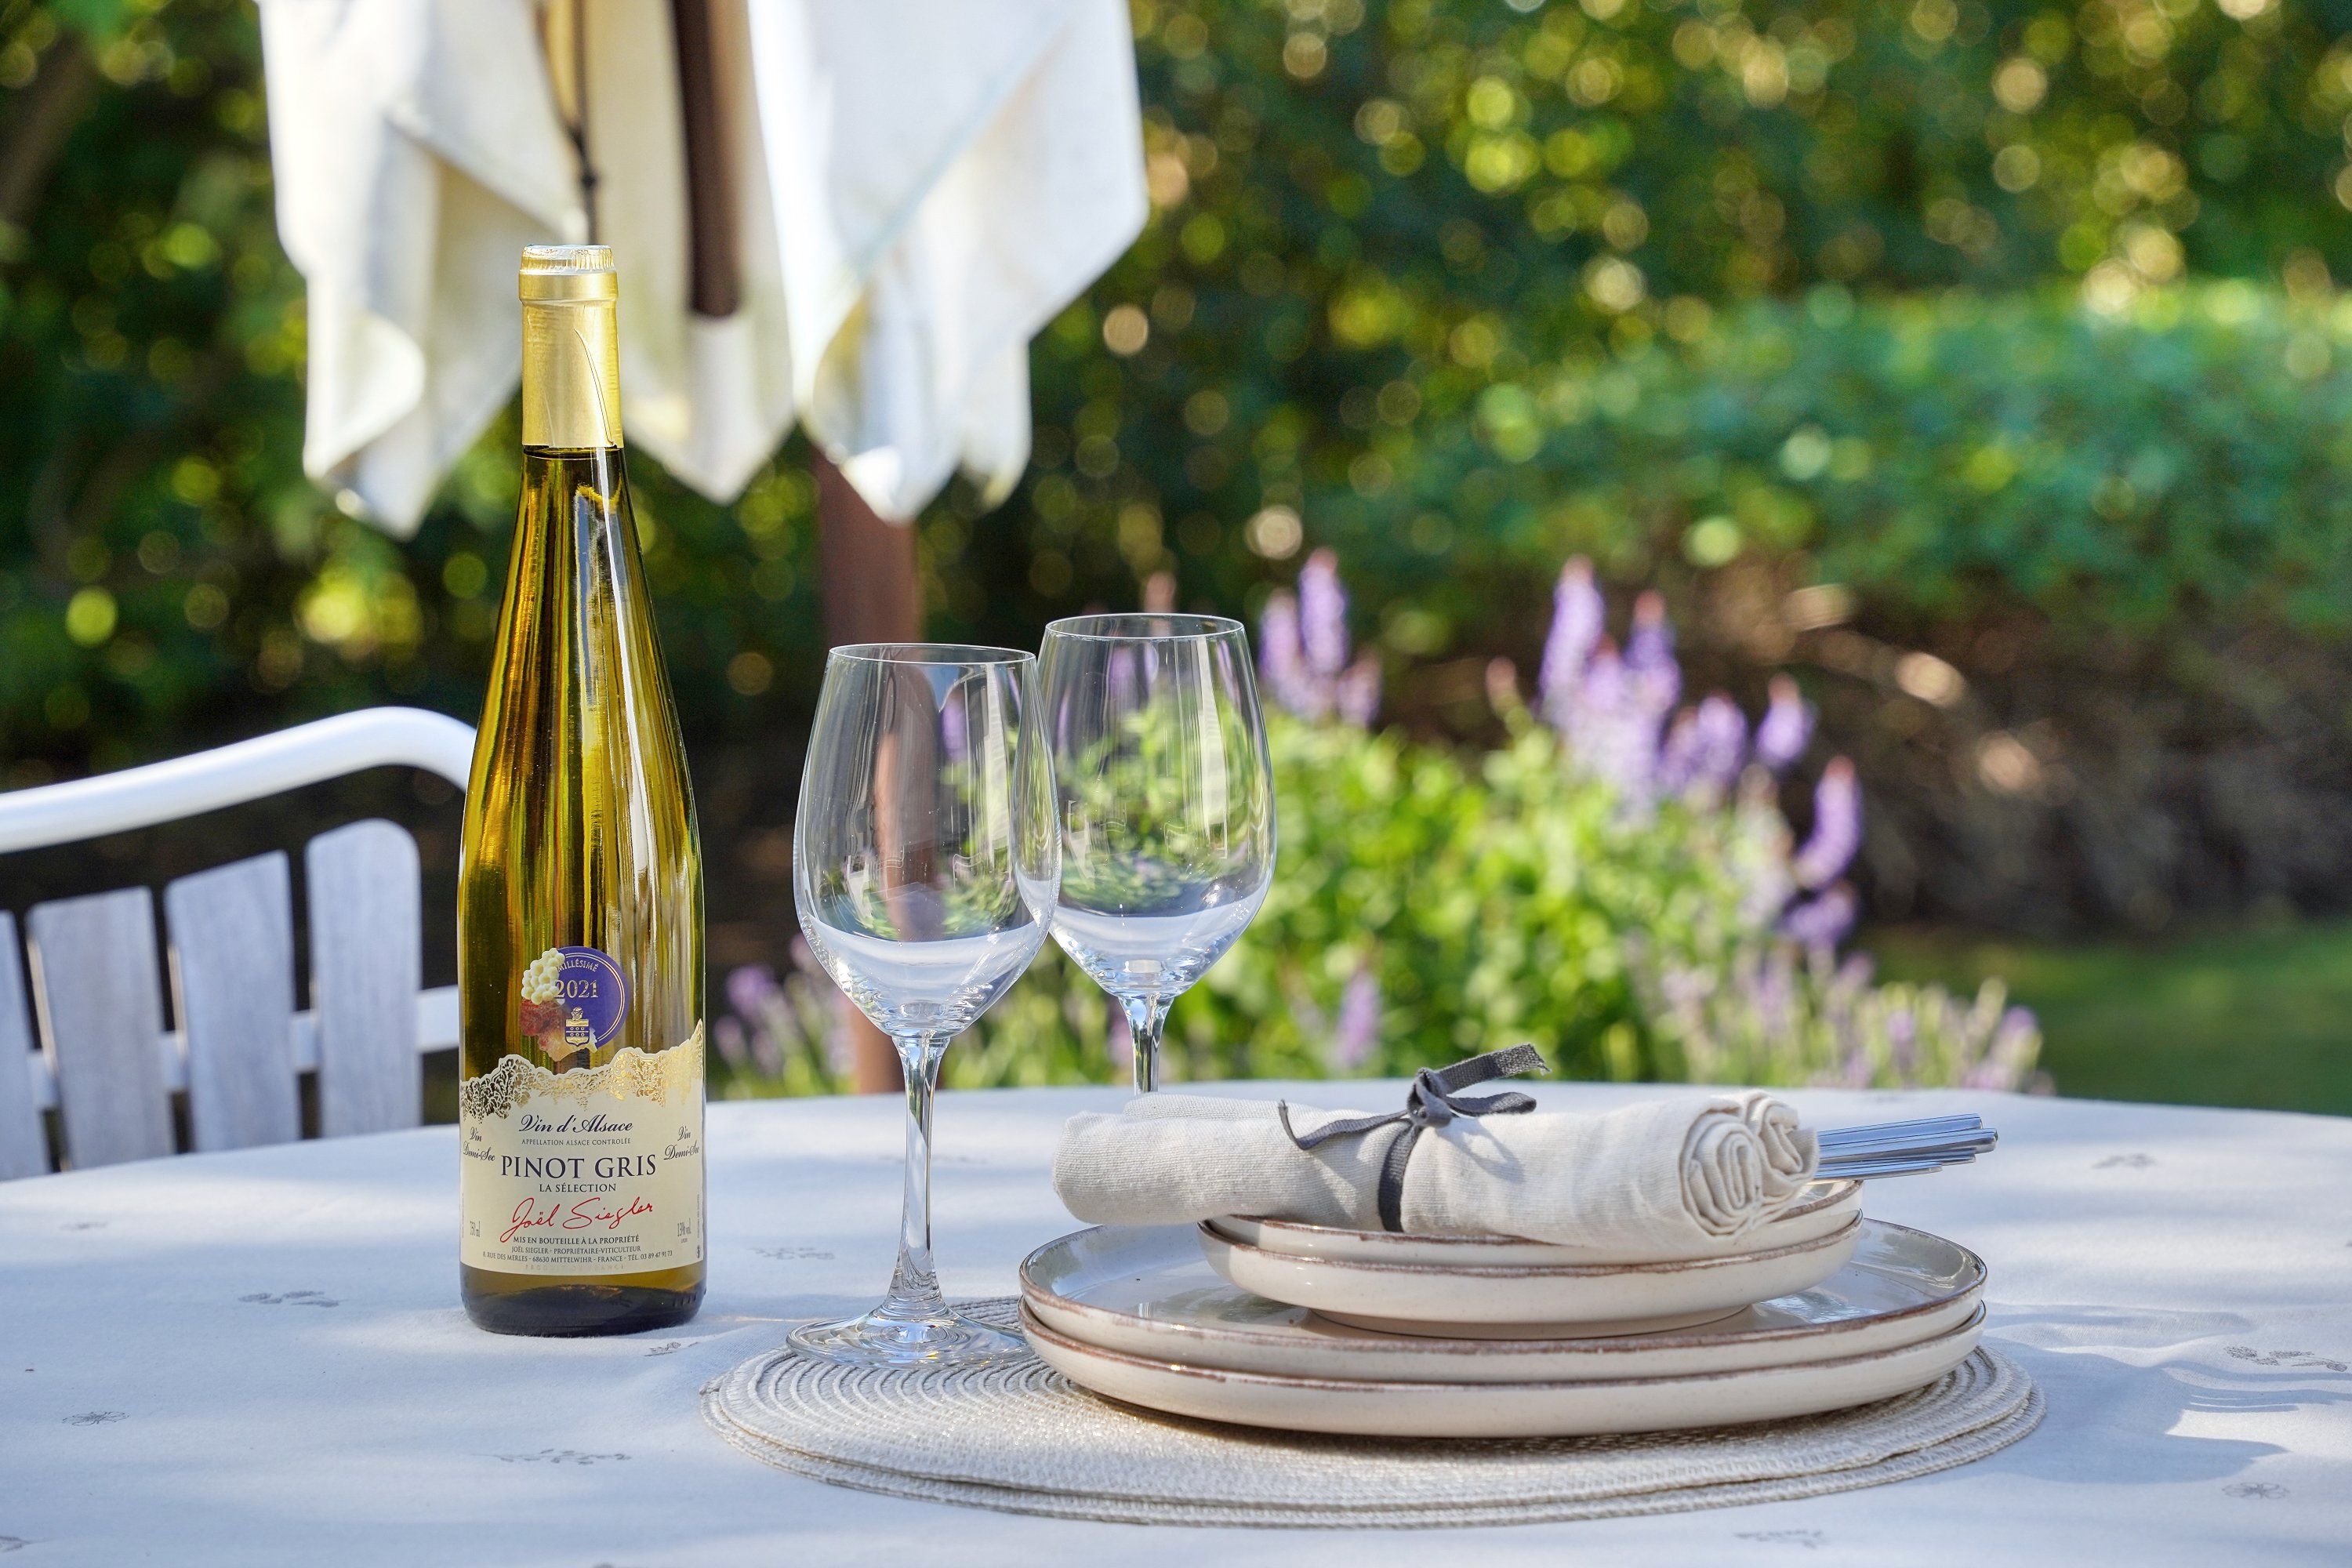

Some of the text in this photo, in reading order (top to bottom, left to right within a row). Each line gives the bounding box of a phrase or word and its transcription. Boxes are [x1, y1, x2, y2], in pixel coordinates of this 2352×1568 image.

[557, 959, 599, 972] MILLÉSIMÉ
[555, 980, 598, 998] 2021
[518, 1114, 553, 1132] Vin
[470, 1126, 482, 1142] Vin
[677, 1125, 691, 1141] Vin
[463, 1141, 495, 1161] Demi-Sec
[501, 1154, 656, 1178] PINOT GRIS
[539, 1182, 616, 1192] LA SÉLECTION
[499, 1197, 561, 1243] Joël
[562, 1196, 653, 1229] Siegler
[599, 1234, 640, 1244] PROPRIÉTÉ
[554, 1246, 641, 1254] PROPRIÉTAIRE-VITICULTEUR
